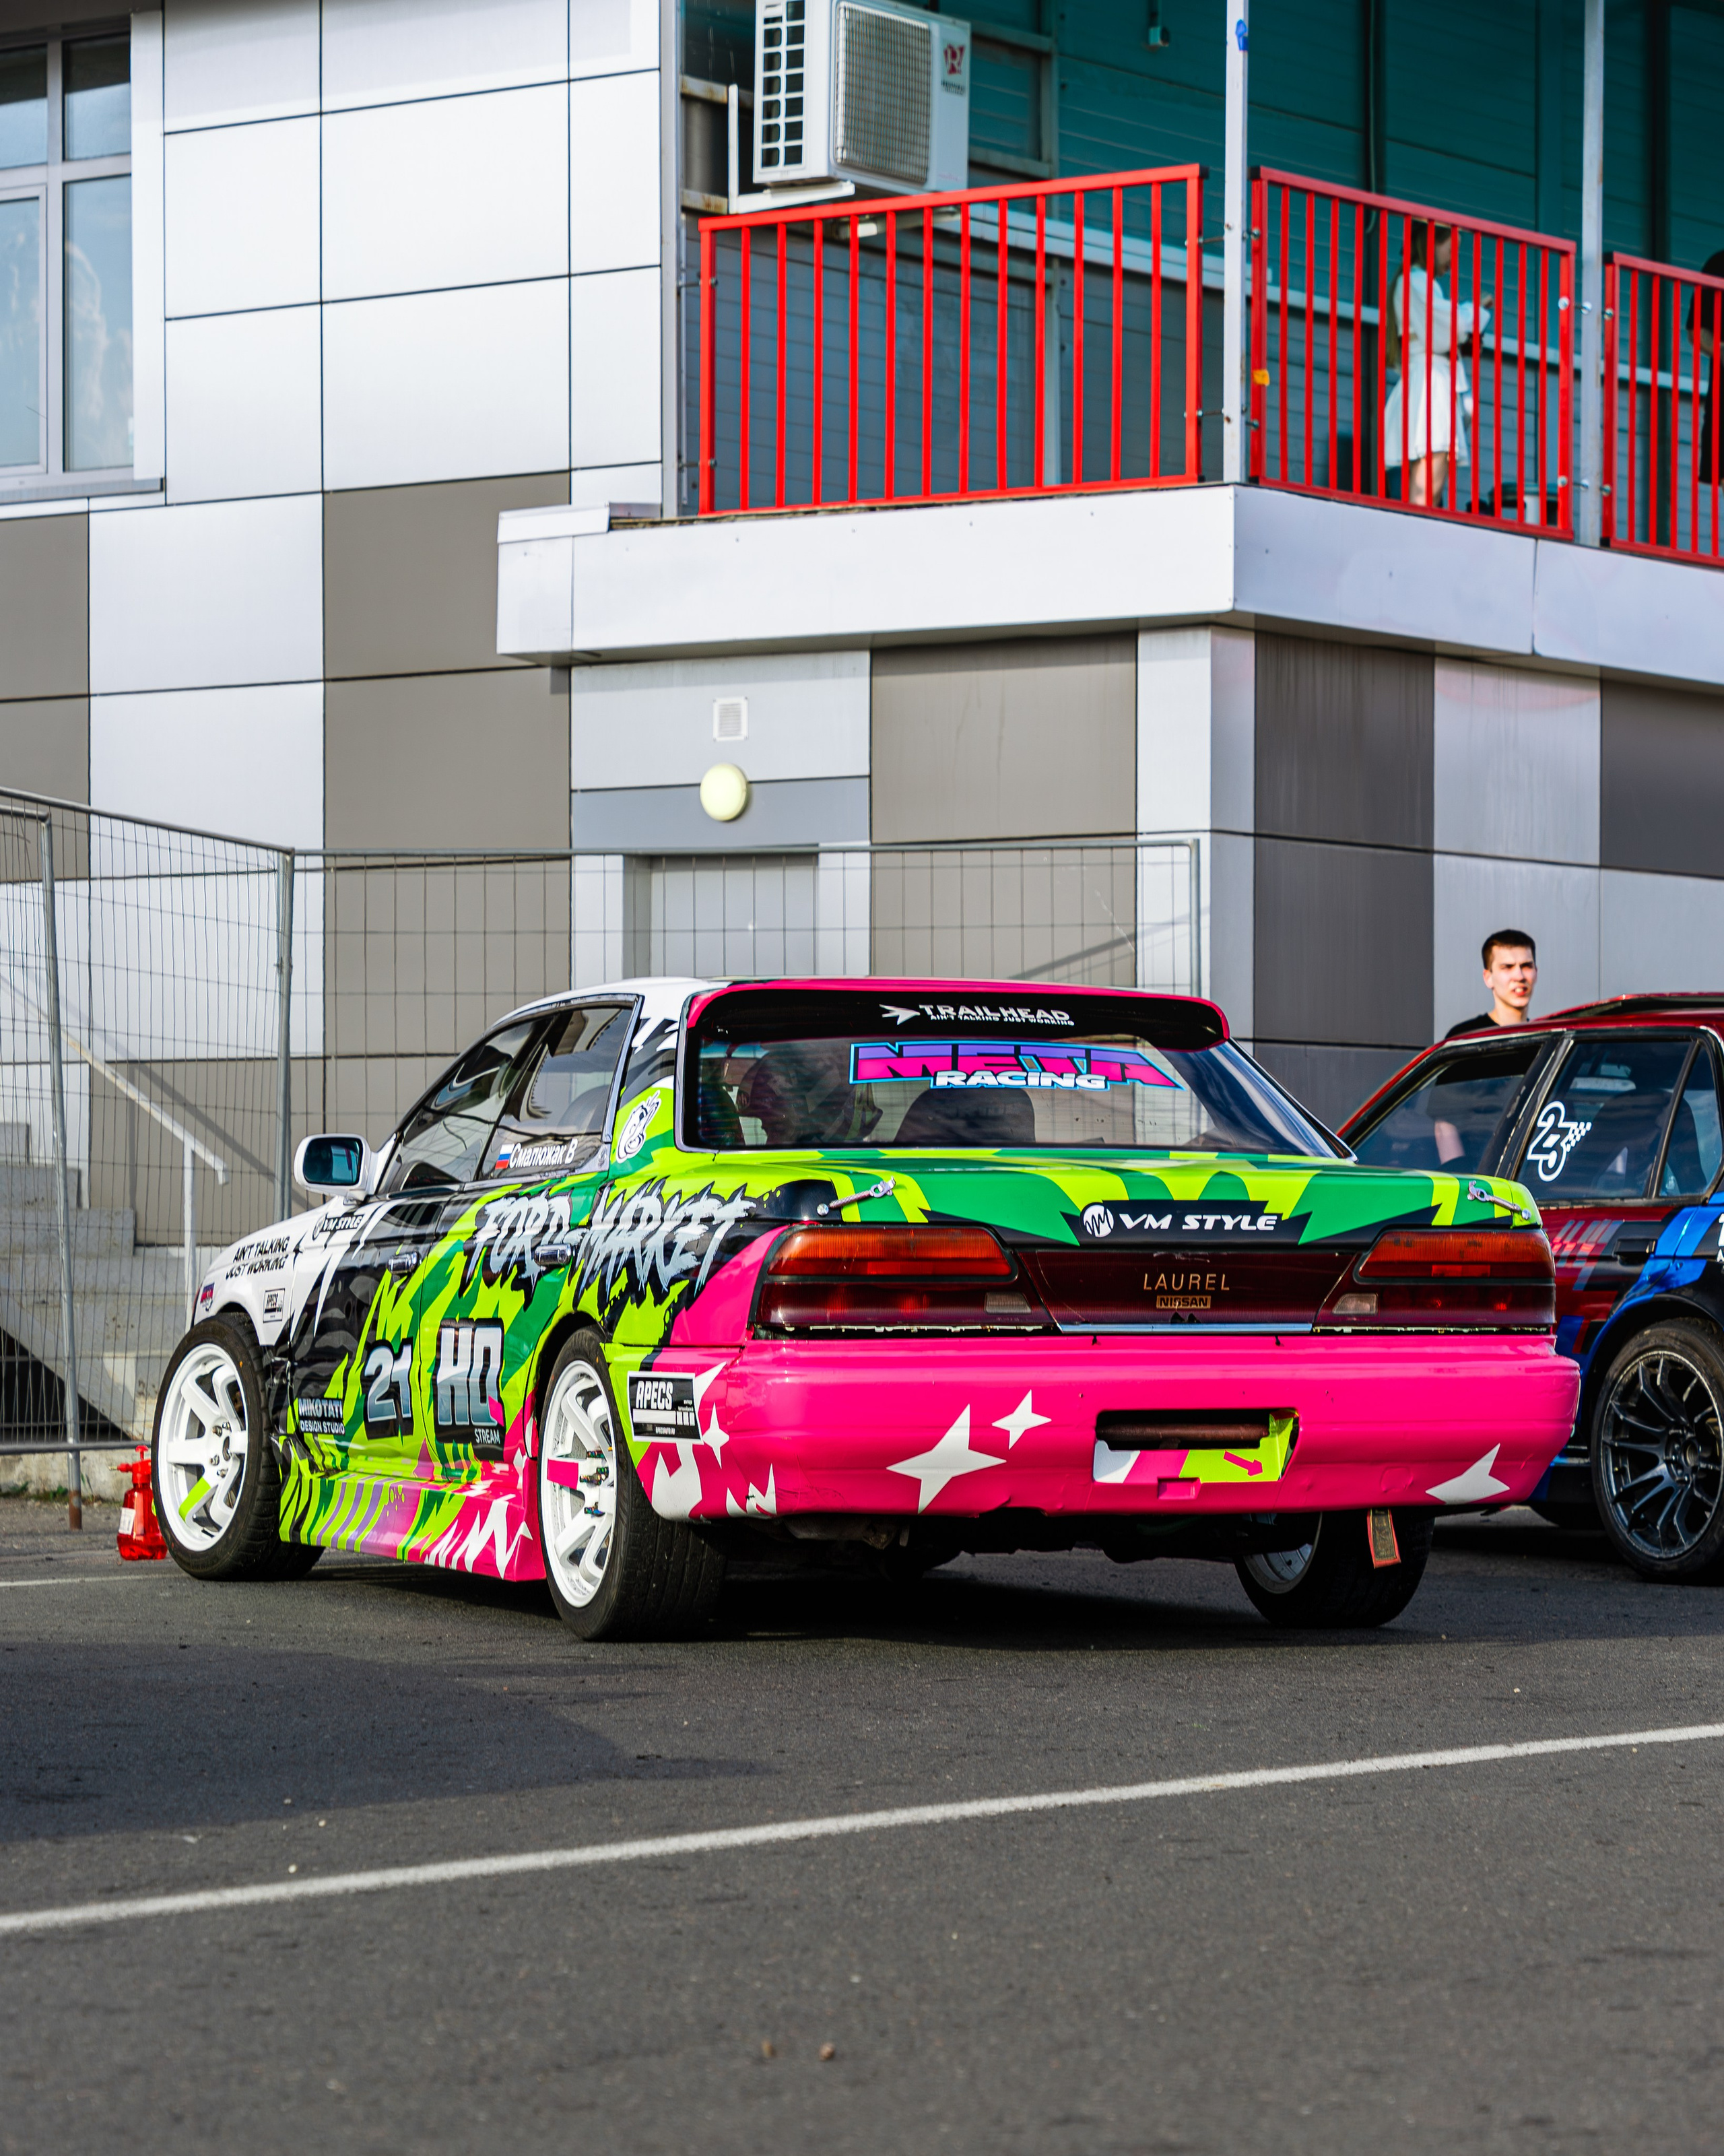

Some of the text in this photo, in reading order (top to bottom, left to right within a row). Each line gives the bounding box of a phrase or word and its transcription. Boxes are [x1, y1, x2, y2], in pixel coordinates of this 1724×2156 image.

[919, 1004, 1070, 1021] TRAILHEAD
[1029, 1018, 1075, 1026] WORKING
[935, 1070, 1106, 1090] RACING
[1119, 1213, 1278, 1231] VM STYLE
[254, 1235, 290, 1257] TALKING
[225, 1254, 289, 1280] JUST WORKING
[1143, 1273, 1230, 1291] LAUREL
[1158, 1297, 1209, 1307] NISSAN
[364, 1344, 412, 1422] 21
[636, 1381, 673, 1410] APECS
[298, 1398, 343, 1418] MIKOTATI
[300, 1420, 345, 1435] DESIGN STUDIO
[474, 1427, 500, 1445] STREAM
